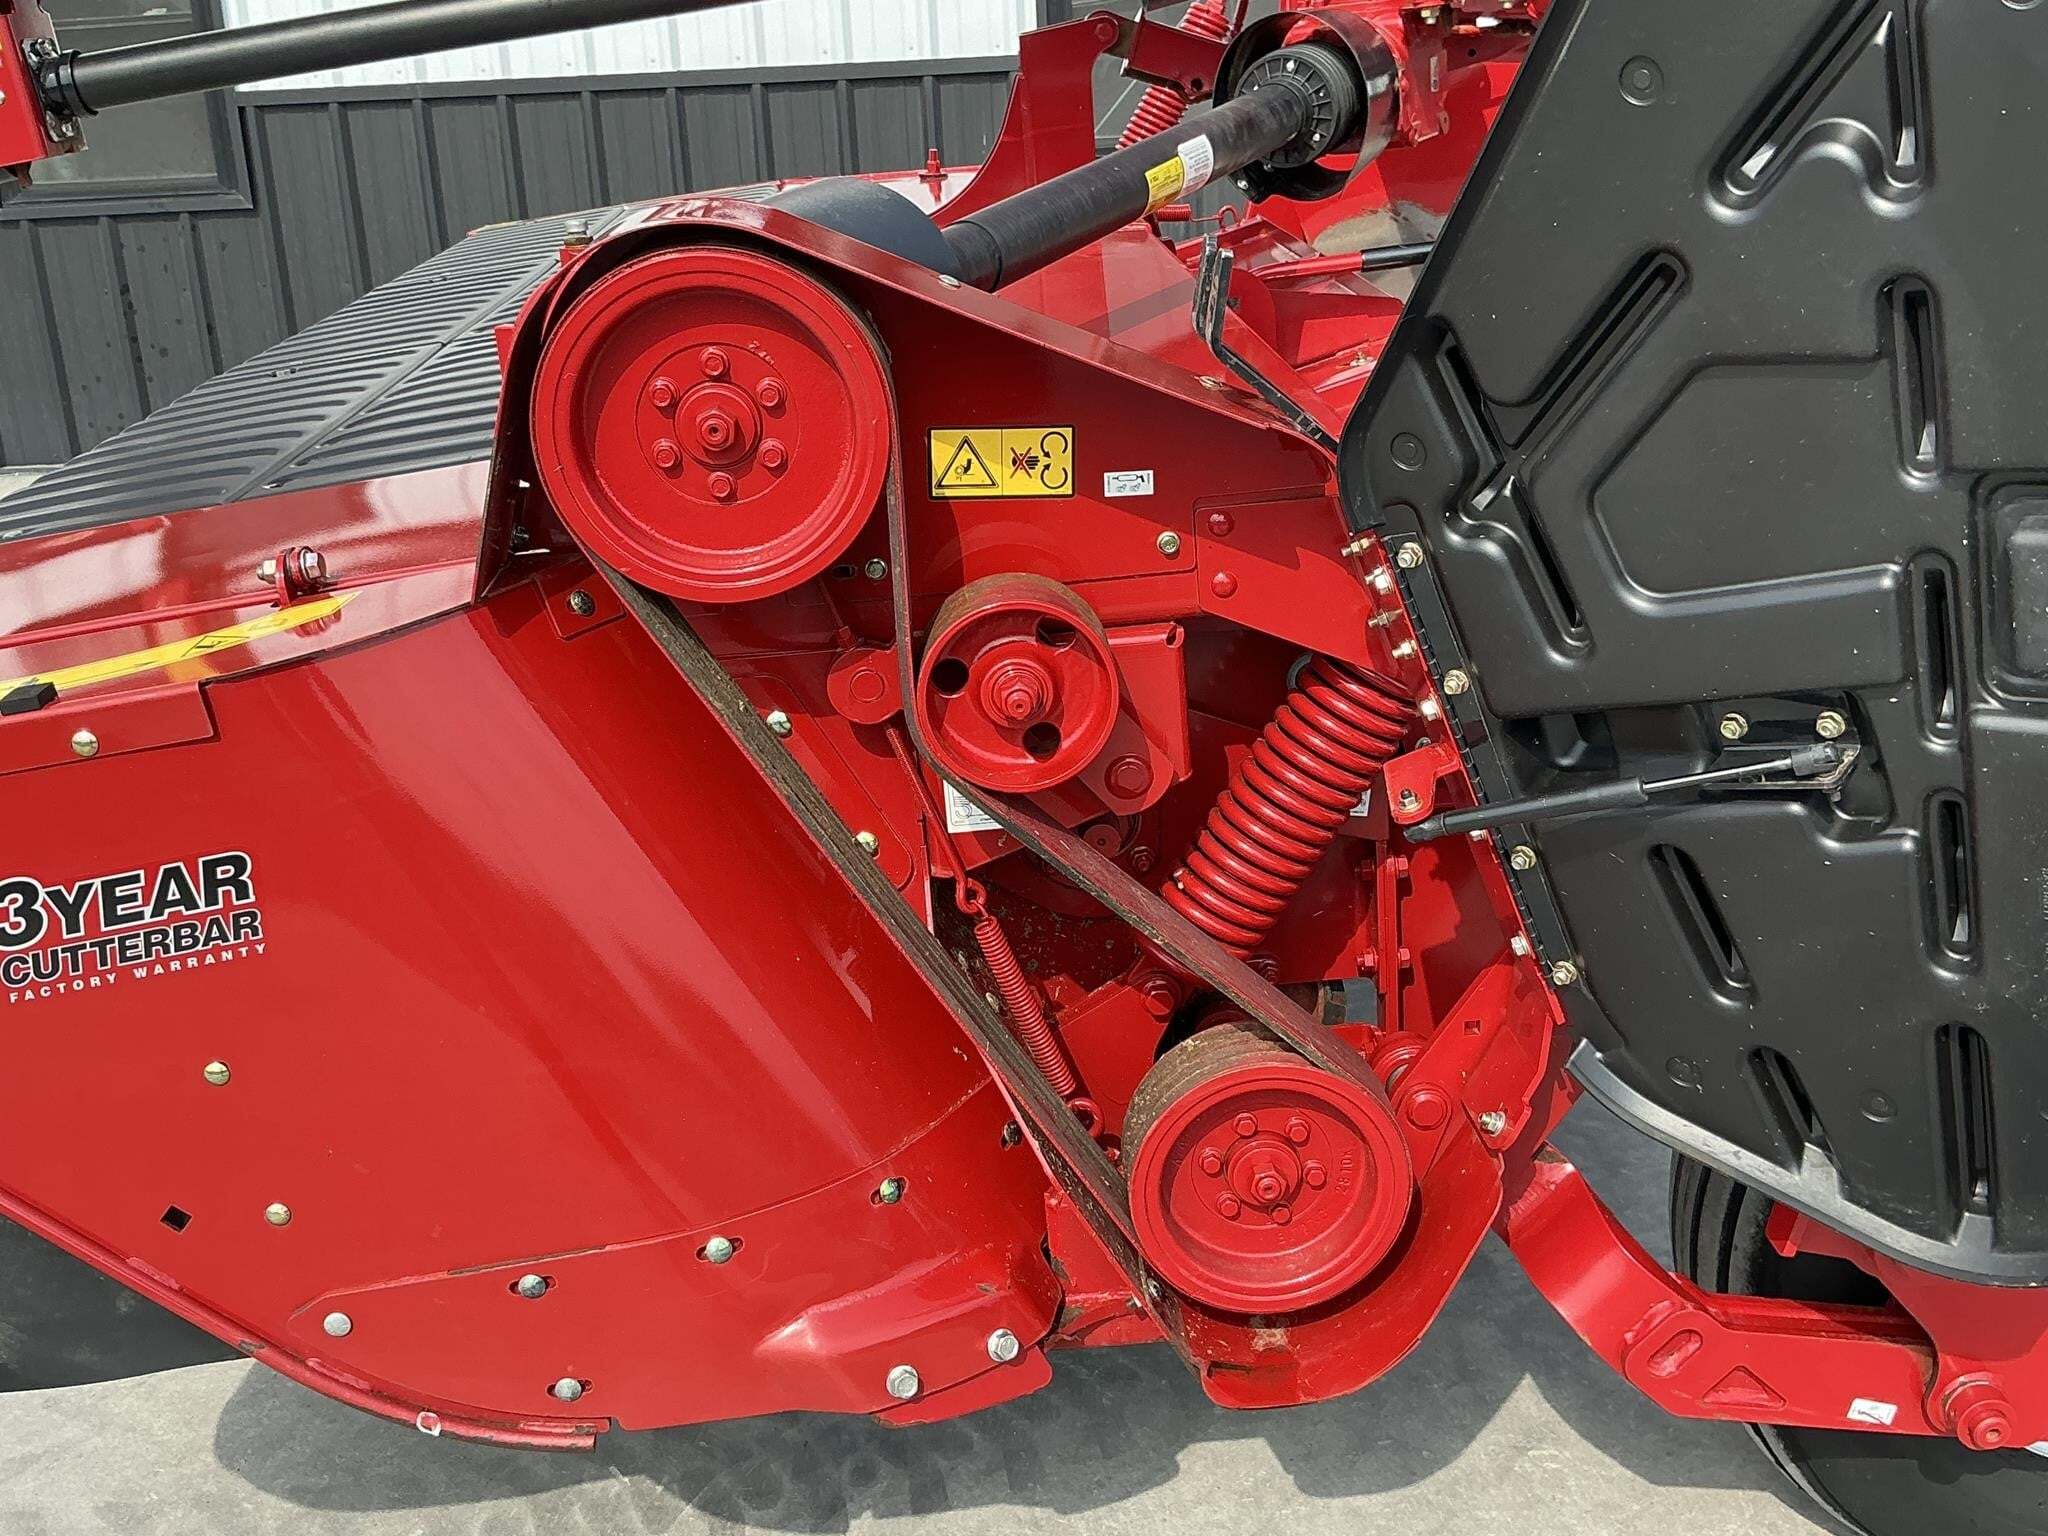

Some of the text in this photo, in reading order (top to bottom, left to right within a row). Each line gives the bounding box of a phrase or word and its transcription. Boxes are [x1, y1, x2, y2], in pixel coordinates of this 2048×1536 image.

[1, 909, 263, 988] CUTTERBAR
[9, 942, 267, 1004] FACTORY WARRANTY
